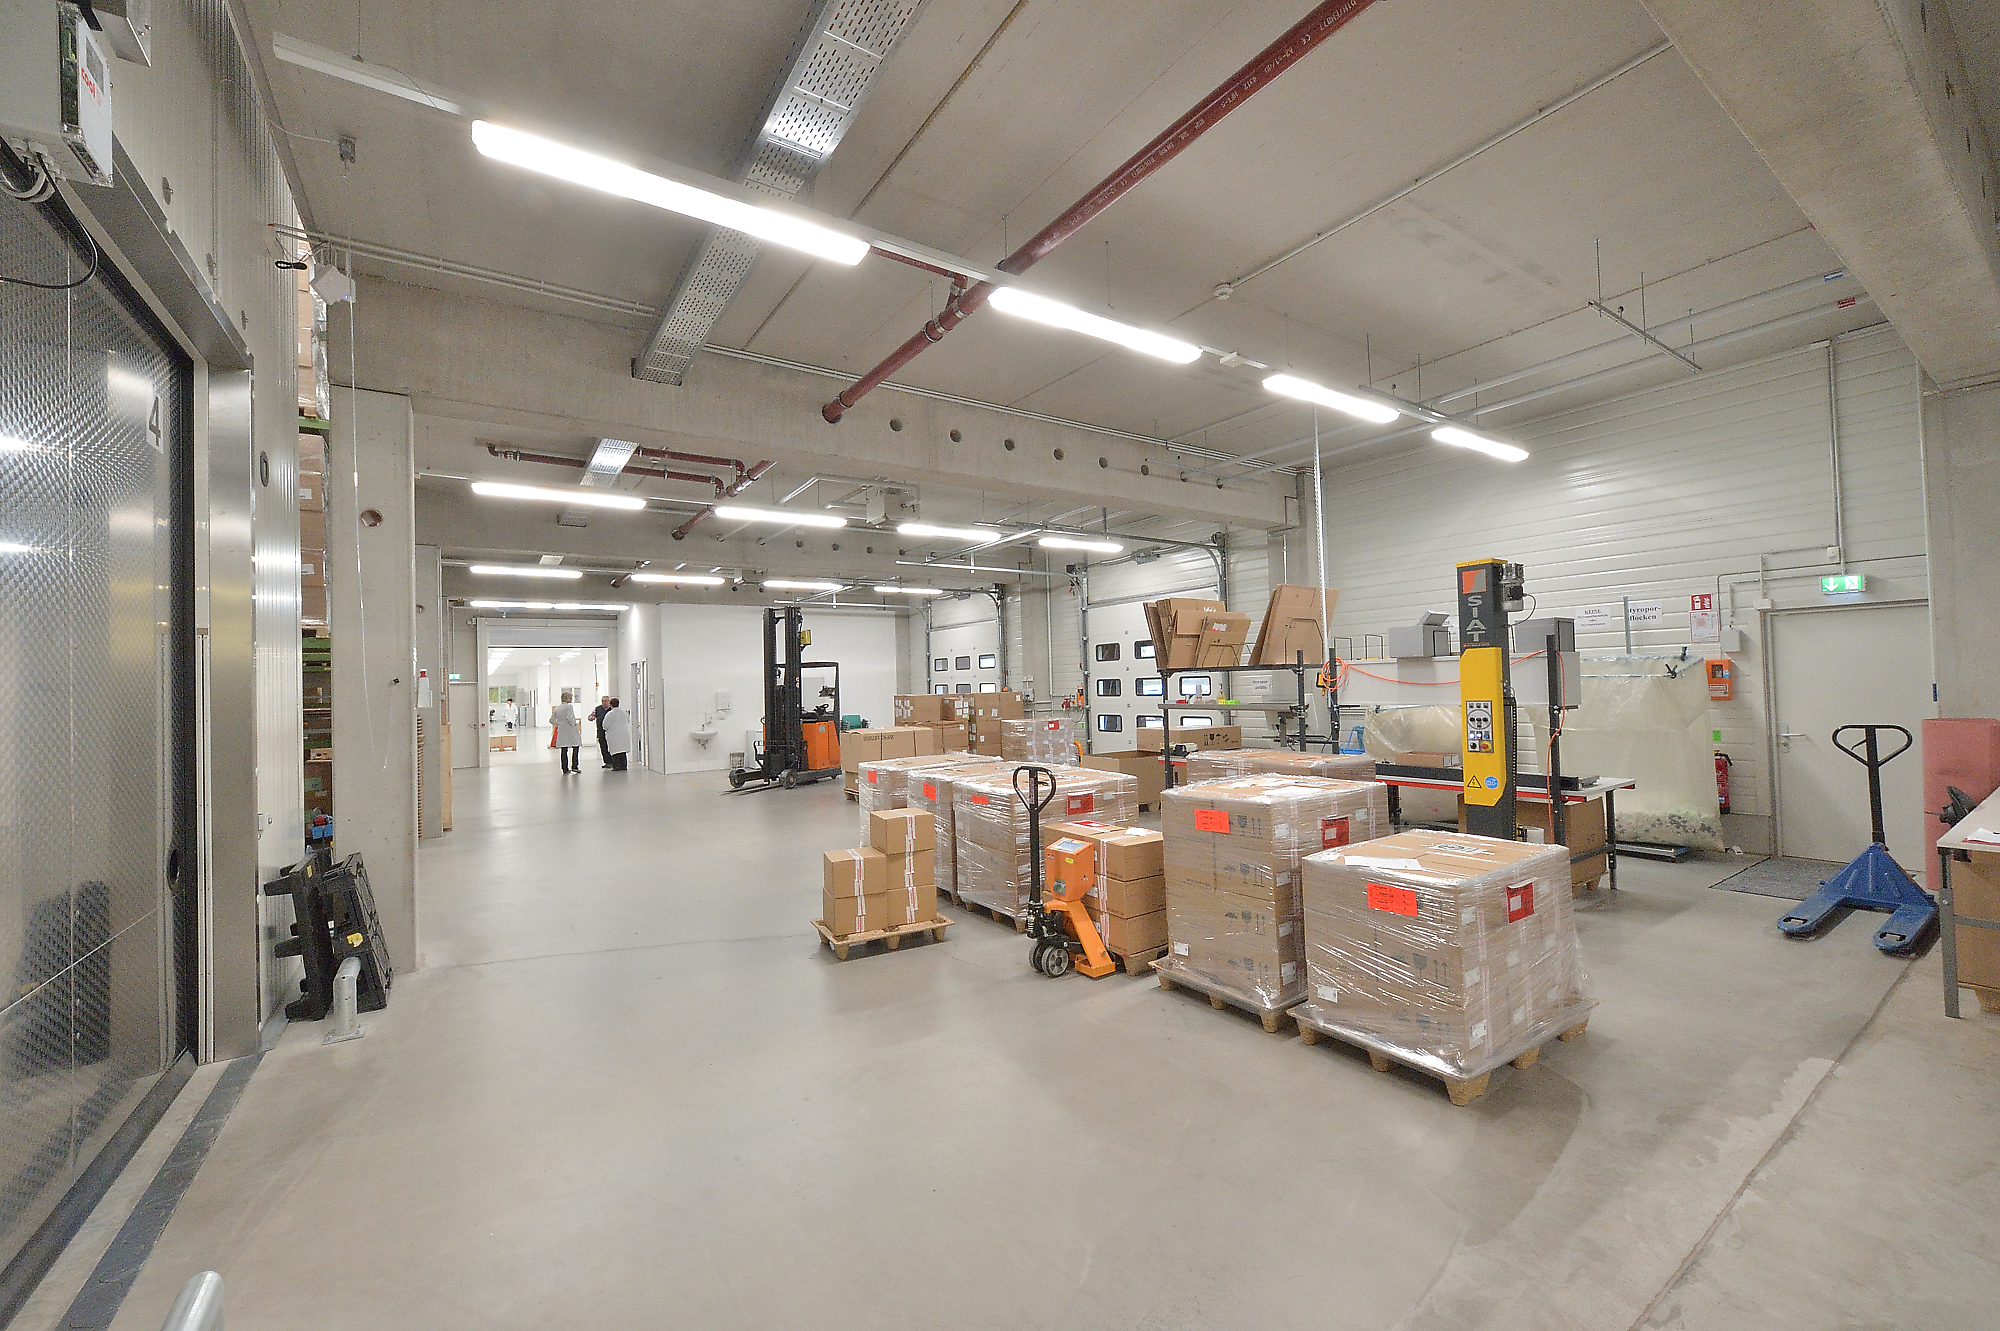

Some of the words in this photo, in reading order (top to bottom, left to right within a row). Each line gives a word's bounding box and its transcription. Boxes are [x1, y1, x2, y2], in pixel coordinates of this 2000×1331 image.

[149, 396, 161, 447] 4
[1466, 595, 1487, 642] SIAT
[1629, 606, 1661, 615] tyropor-
